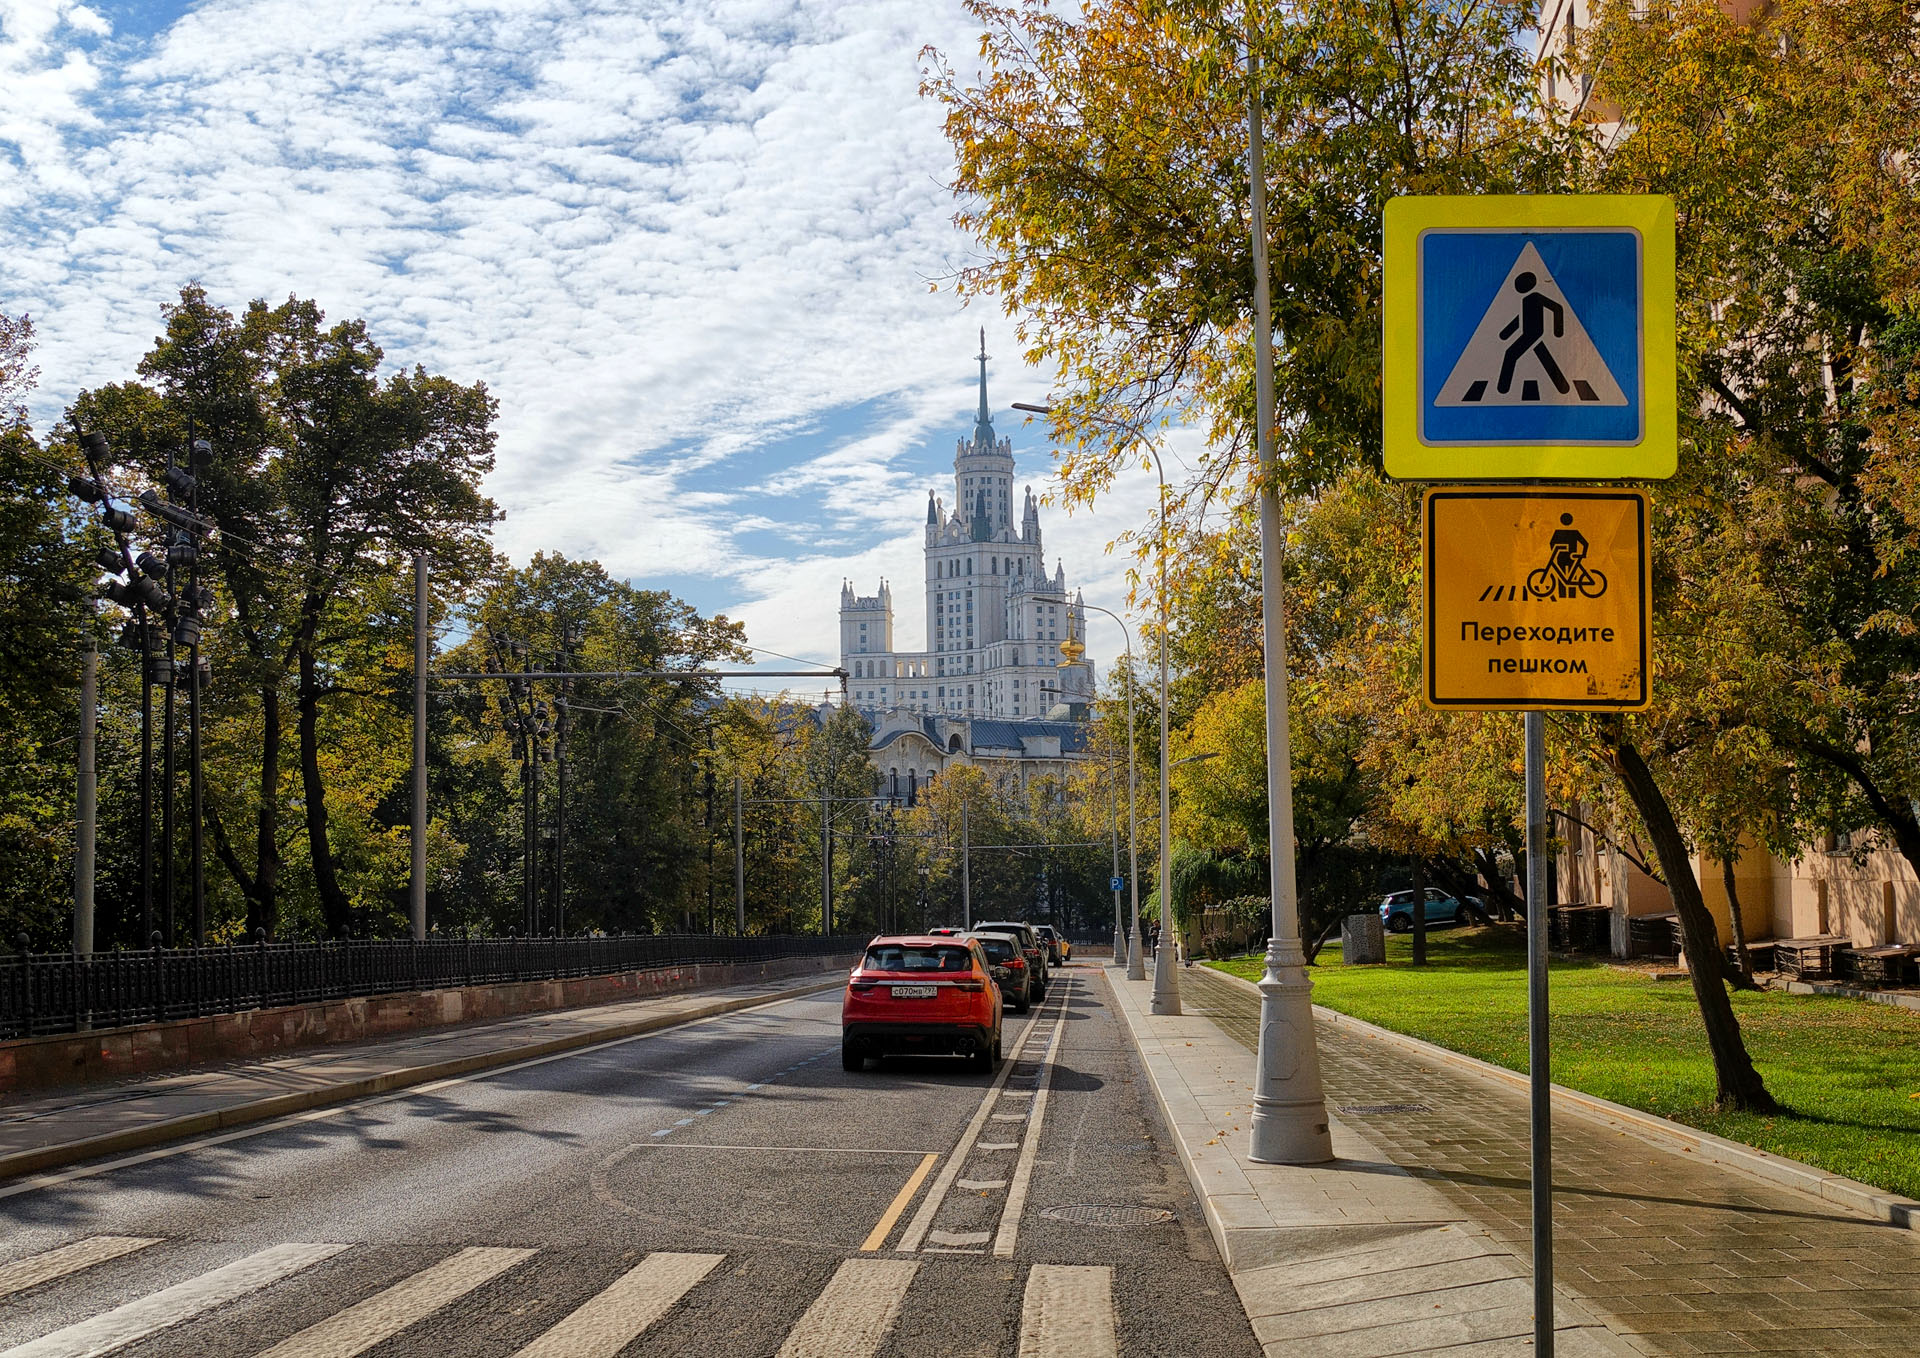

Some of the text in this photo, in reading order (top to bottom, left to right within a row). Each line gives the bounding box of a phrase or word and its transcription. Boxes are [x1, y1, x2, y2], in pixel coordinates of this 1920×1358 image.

[1461, 621, 1614, 645] Переходите
[1488, 658, 1588, 673] пешком
[1111, 879, 1119, 889] P
